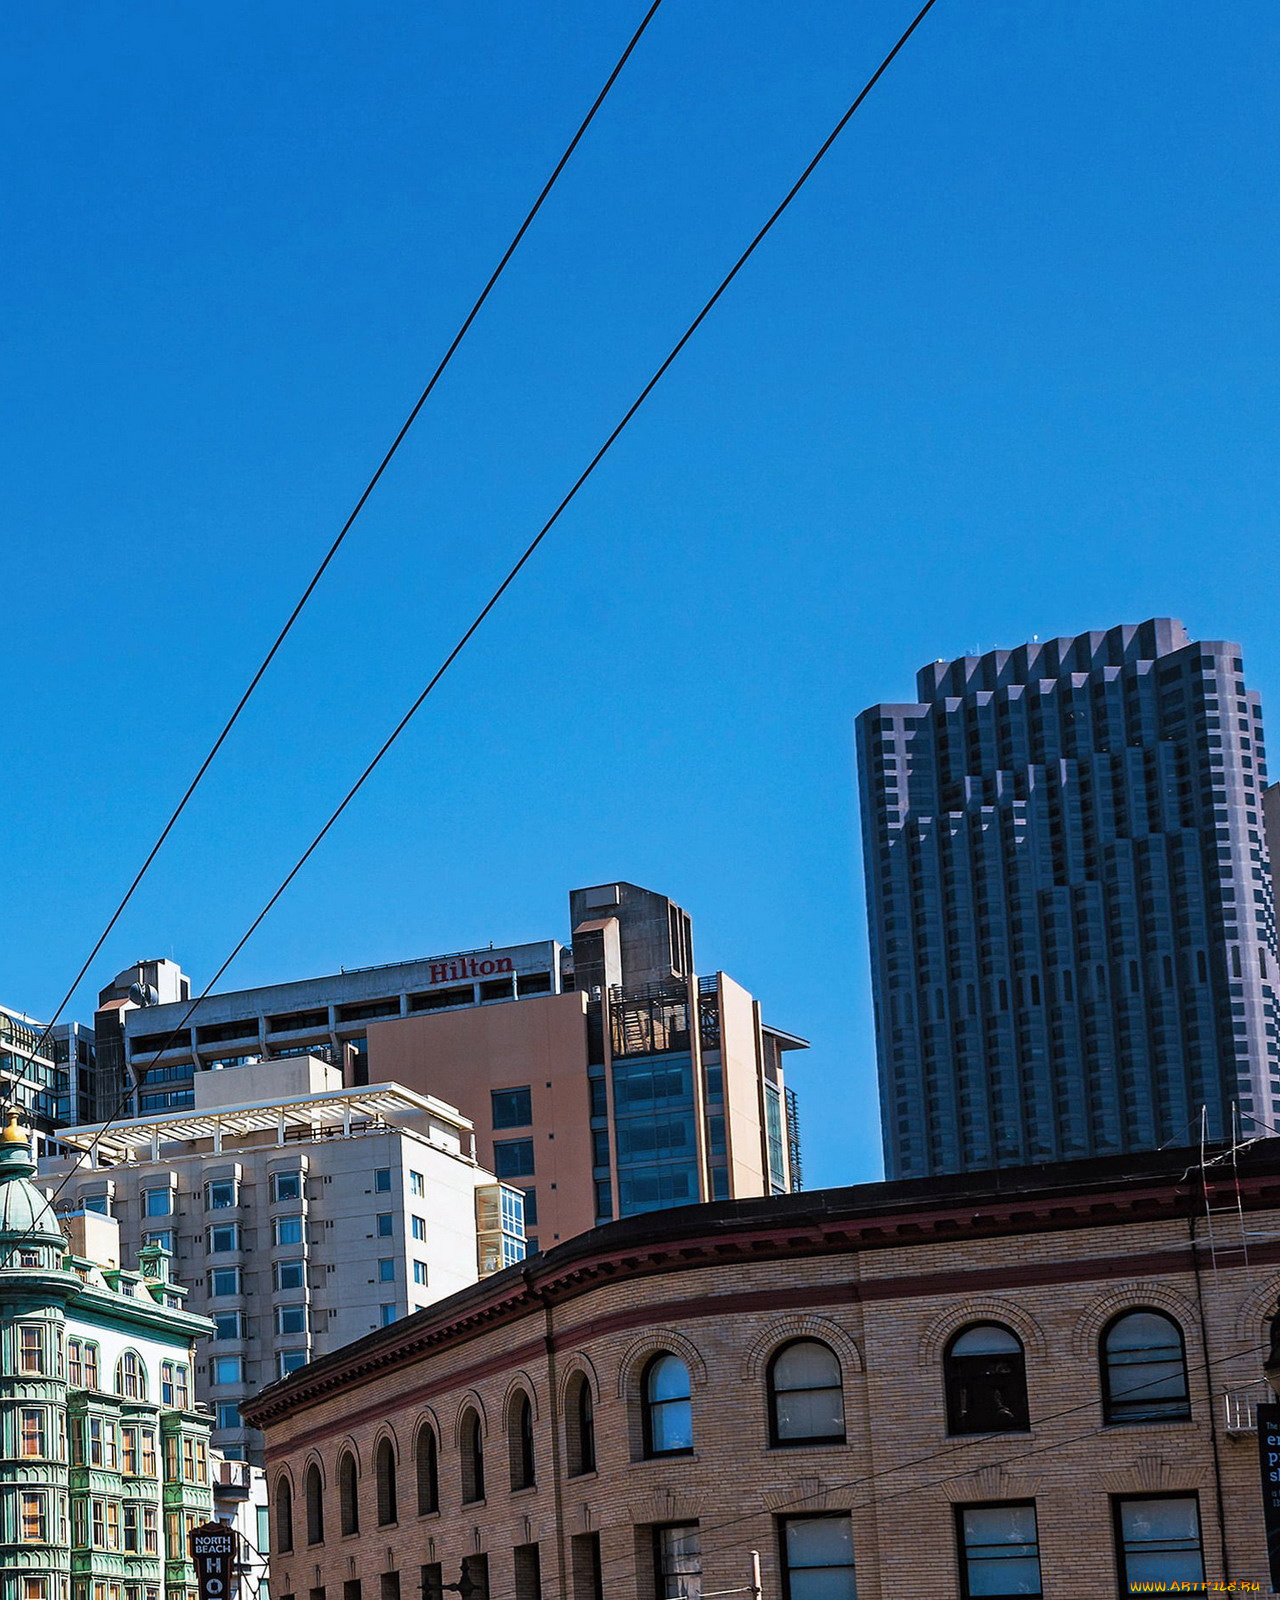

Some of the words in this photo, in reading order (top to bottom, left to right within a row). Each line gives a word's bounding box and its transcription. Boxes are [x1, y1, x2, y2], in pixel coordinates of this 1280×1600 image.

[429, 957, 516, 984] Hilton
[195, 1536, 231, 1545] NORTH
[195, 1545, 231, 1553] BEACH
[206, 1557, 224, 1600] HO
